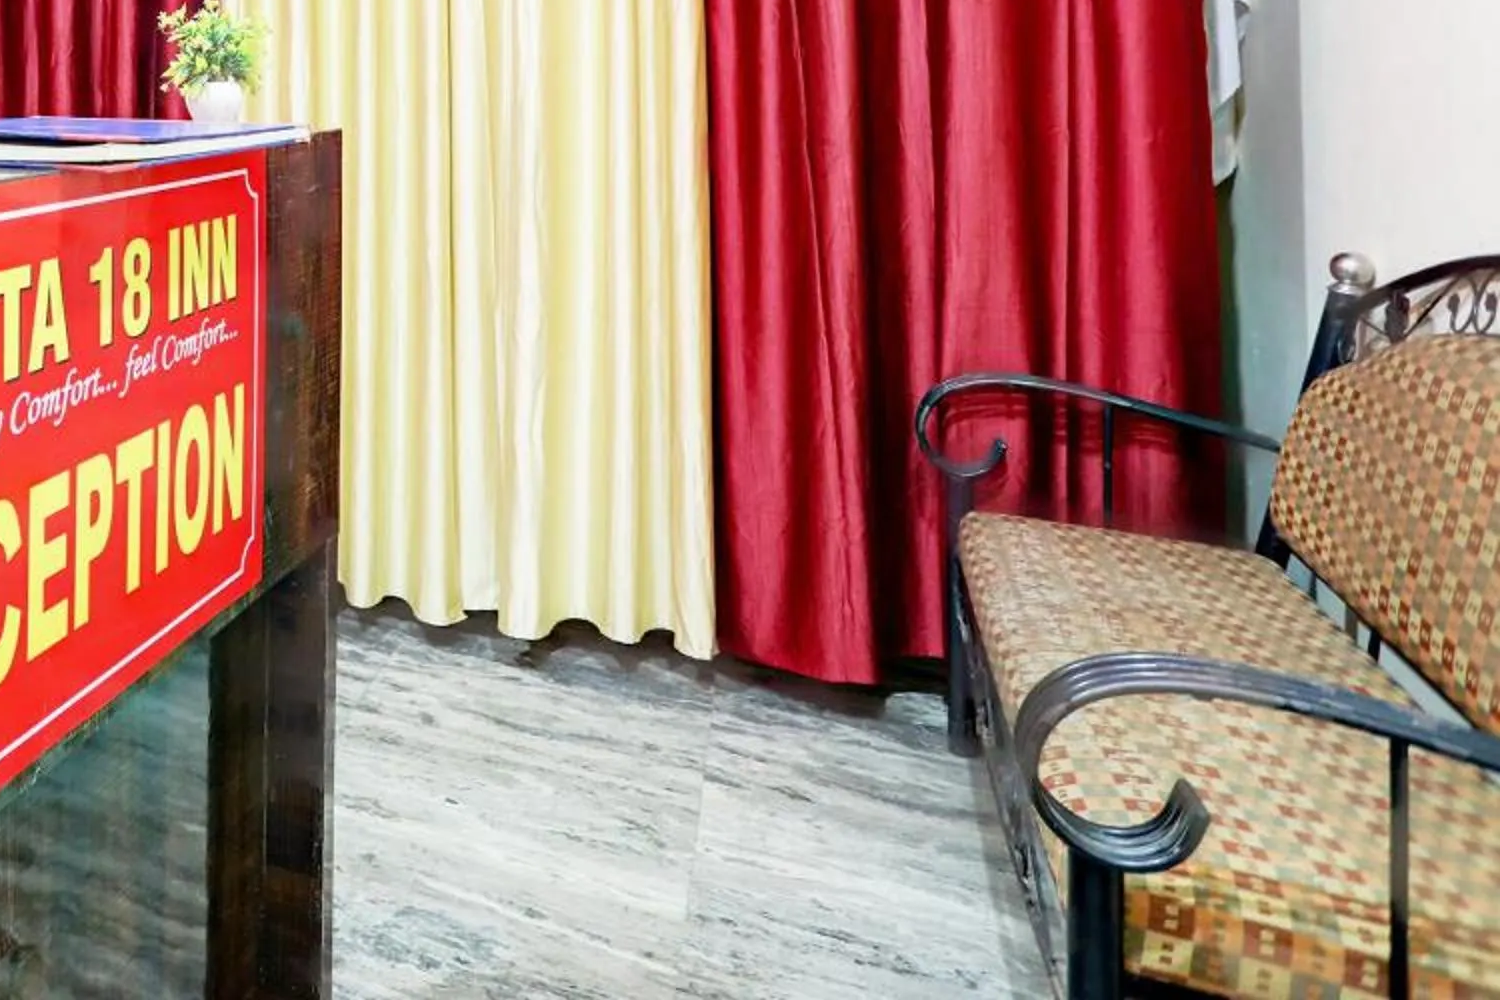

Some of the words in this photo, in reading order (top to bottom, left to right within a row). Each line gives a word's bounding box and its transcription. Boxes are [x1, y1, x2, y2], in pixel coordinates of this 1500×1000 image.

[89, 237, 153, 348] 18
[168, 213, 238, 322] INN
[9, 367, 117, 435] Comfort...
[118, 336, 160, 399] feel
[161, 317, 239, 371] Comfort...
